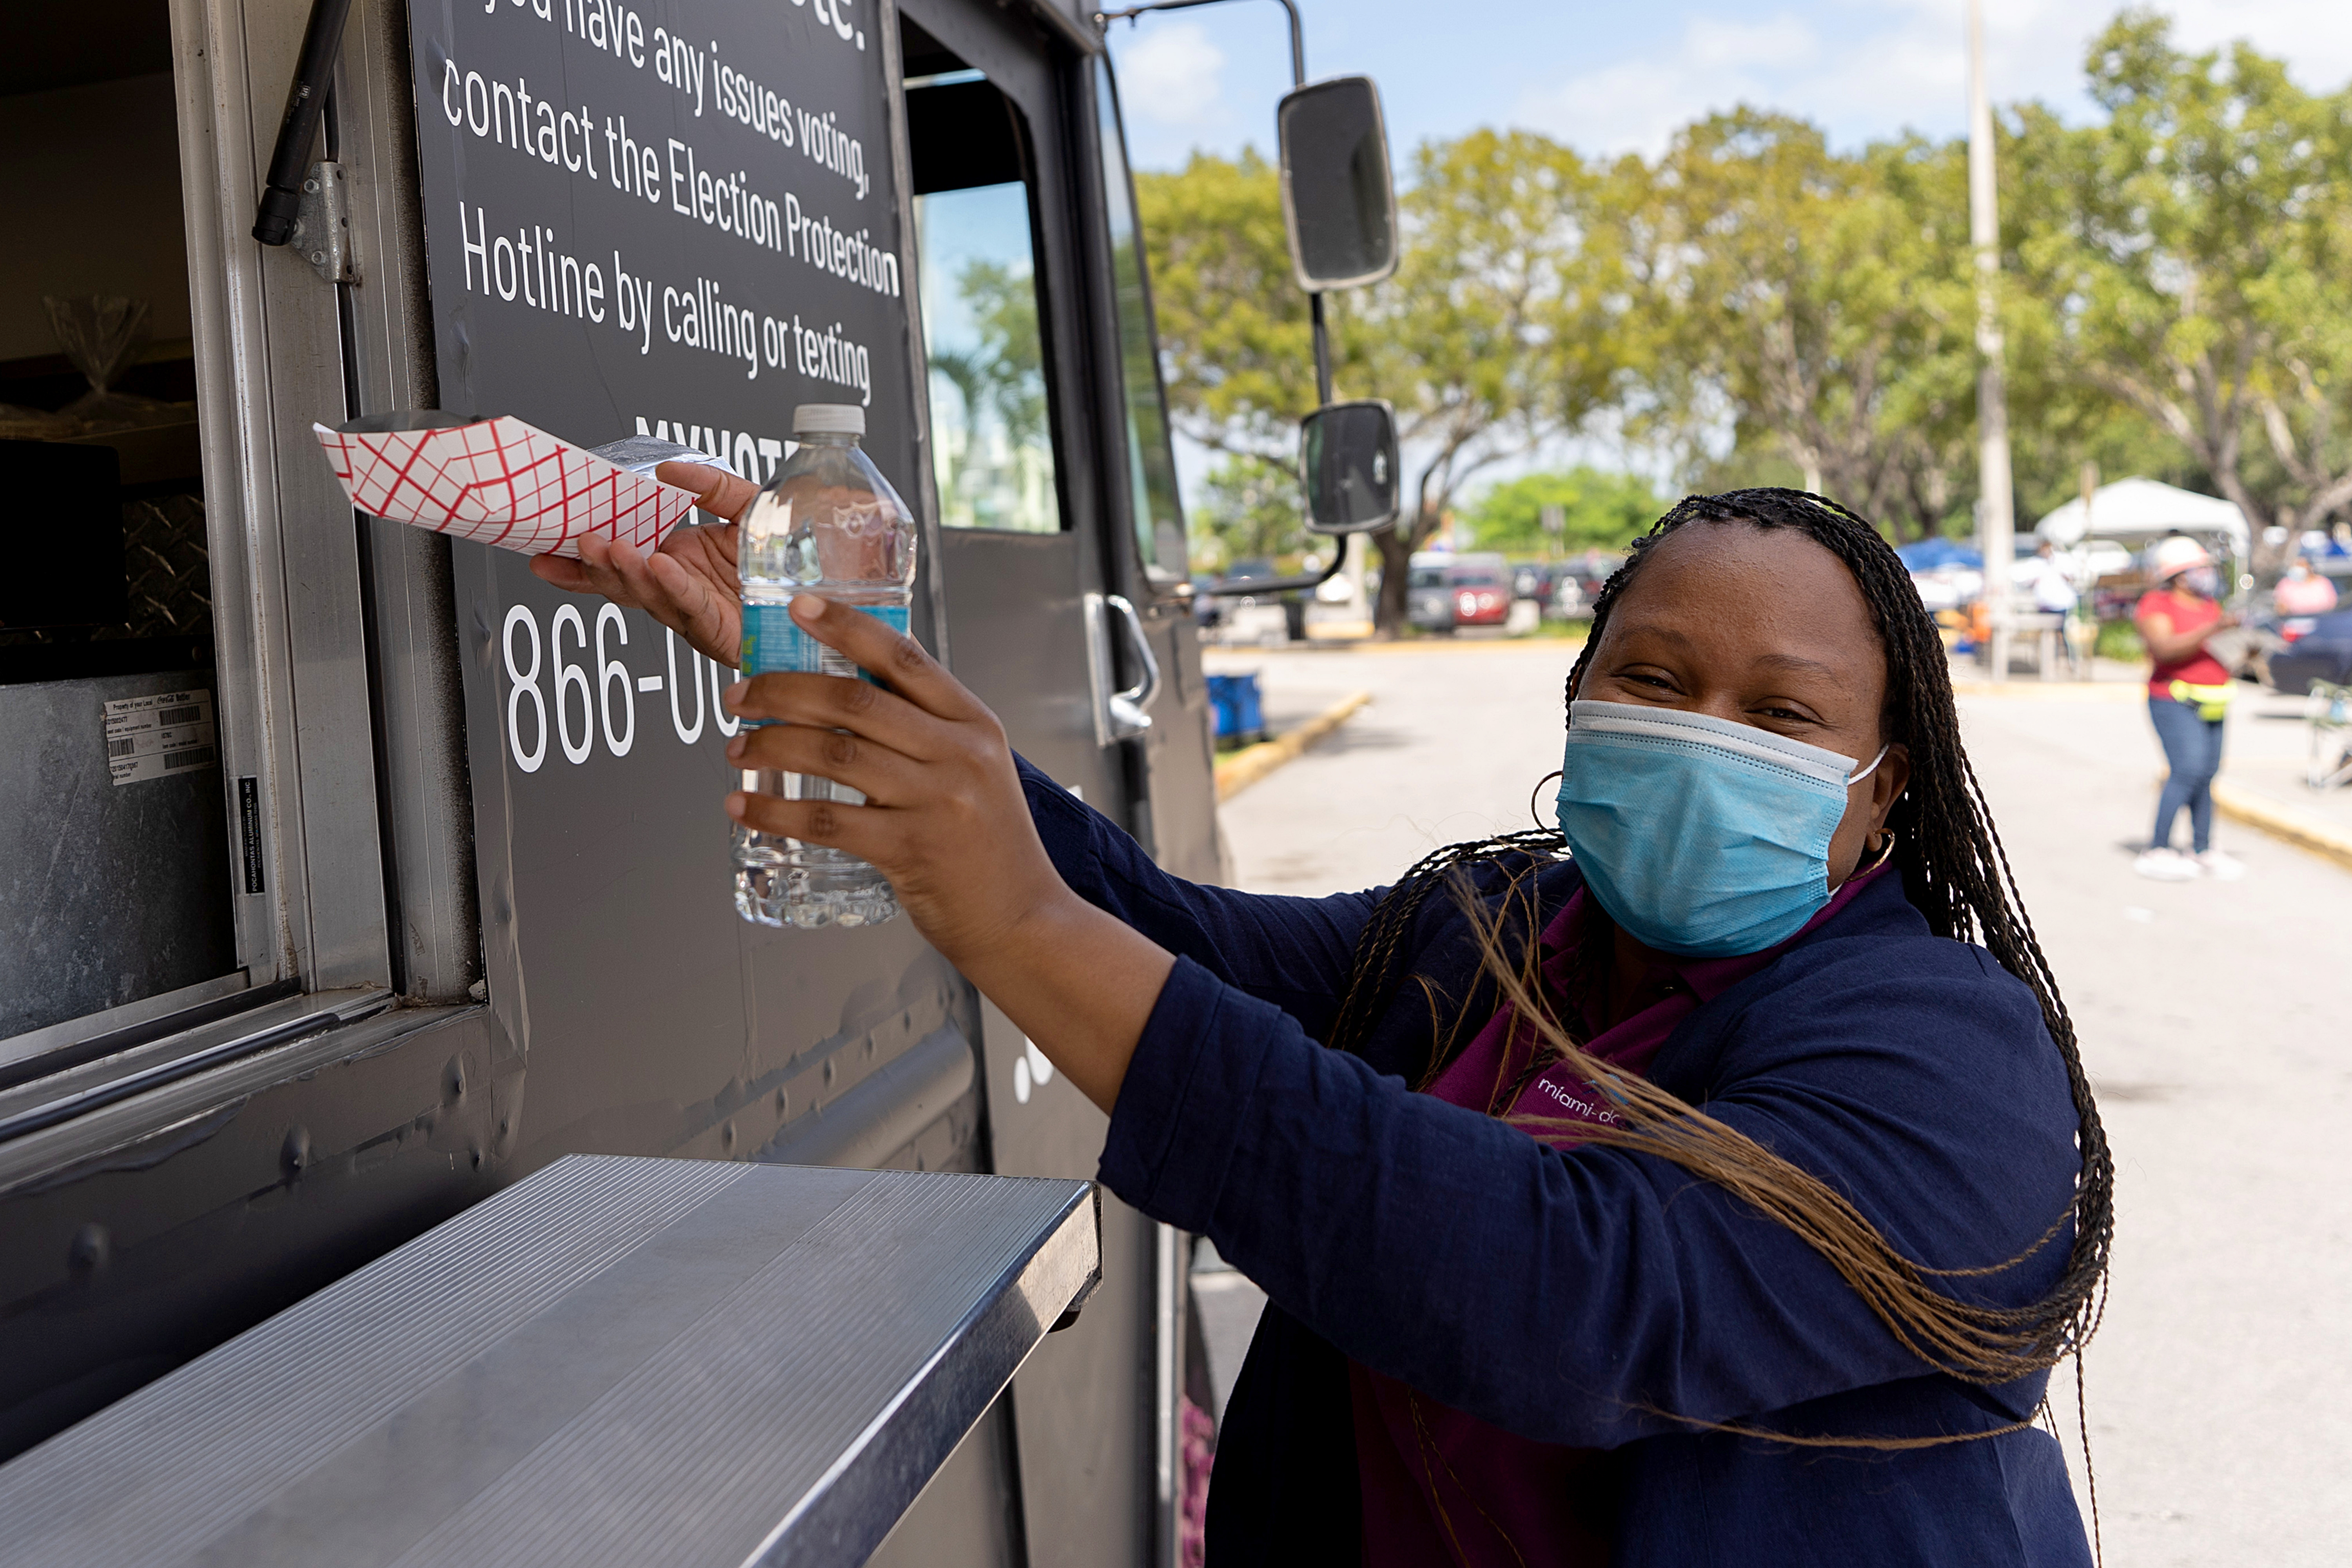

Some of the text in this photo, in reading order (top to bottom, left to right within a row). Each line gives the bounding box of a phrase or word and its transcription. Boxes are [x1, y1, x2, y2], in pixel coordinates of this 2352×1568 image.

[443, 58, 900, 298] contact the Election Protection
[653, 27, 704, 117] any
[711, 40, 794, 148] issues
[796, 107, 869, 200] voting,
[459, 200, 871, 407] Hotline by calling or texting
[249, 846, 257, 891] POCAHONTAS
